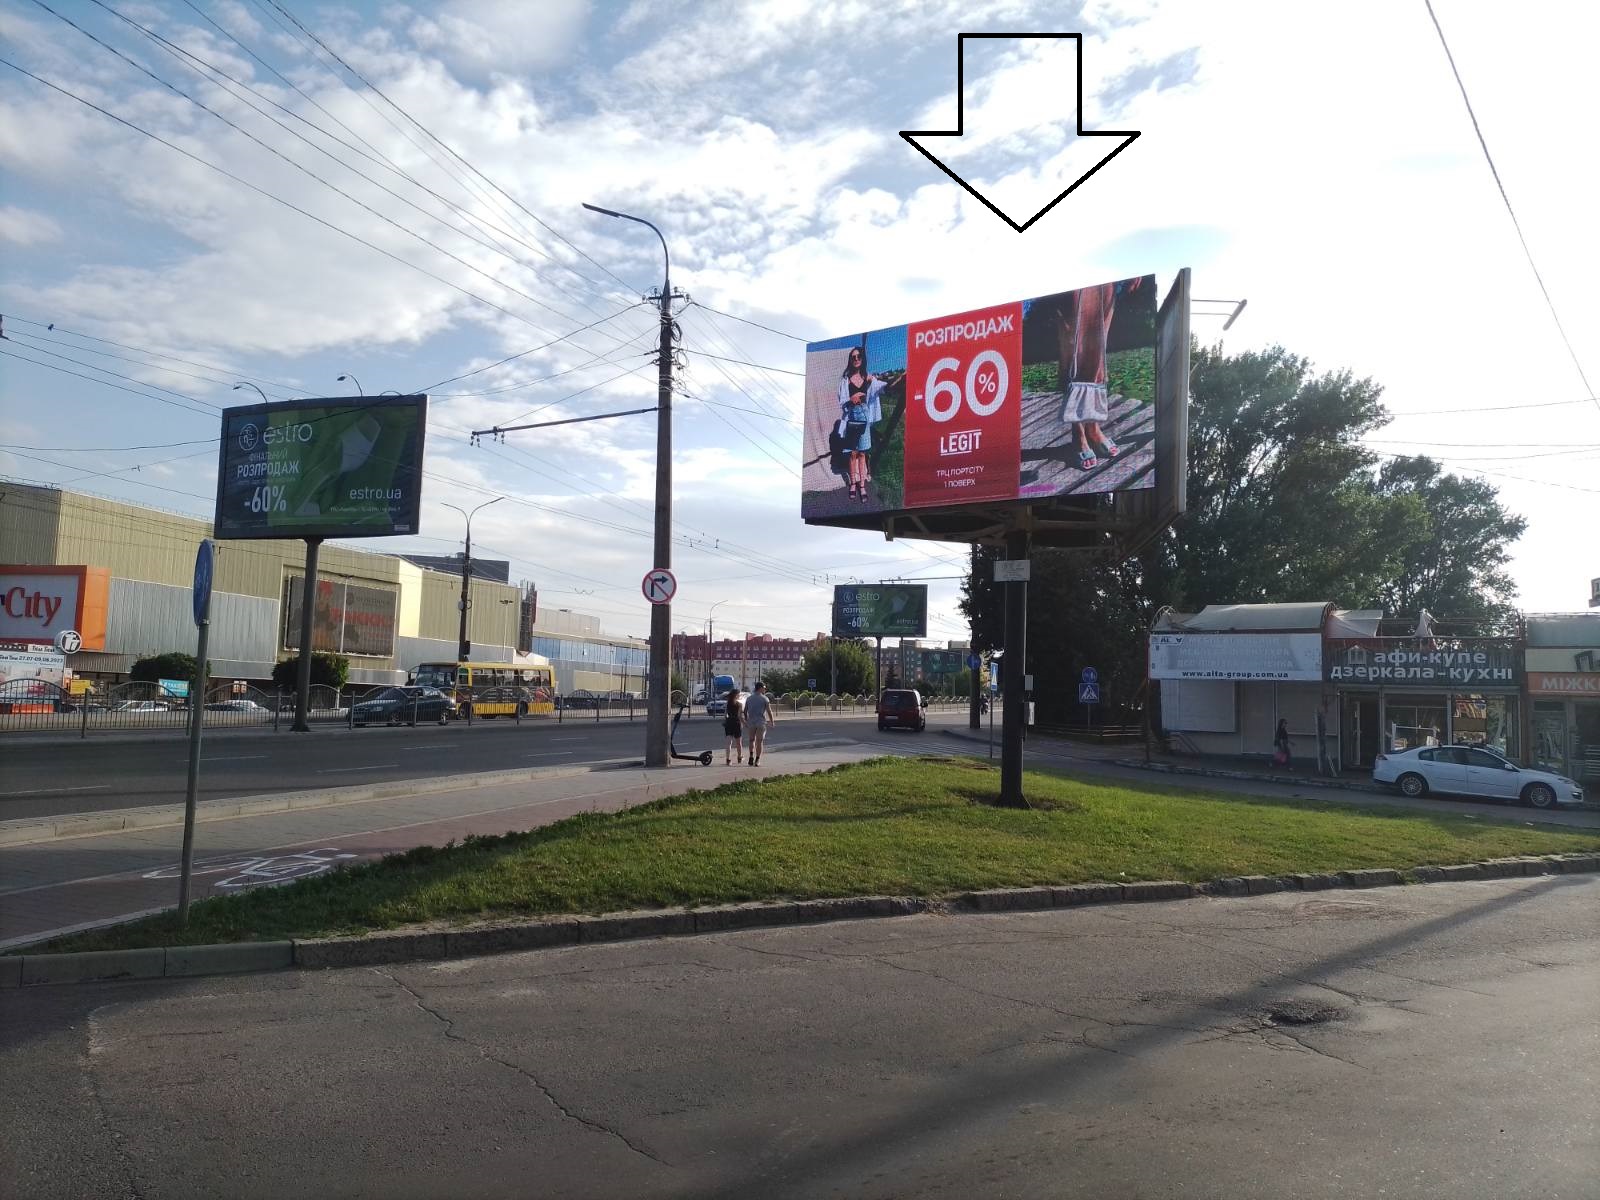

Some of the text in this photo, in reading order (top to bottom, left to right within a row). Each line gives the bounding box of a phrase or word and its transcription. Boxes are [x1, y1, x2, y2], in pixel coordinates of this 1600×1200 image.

[915, 314, 1014, 349] РОЗПРОДАЖ
[263, 420, 313, 444] estro
[940, 430, 982, 455] LEGIT
[237, 459, 300, 478] РОЗПРОДАЖ
[936, 469, 950, 479] ТРЦ
[948, 478, 976, 488] ПОВЕРХ
[243, 485, 287, 513] -60%
[349, 487, 402, 500] estro.ua
[855, 591, 880, 601] estro
[847, 616, 870, 628] -60%
[1182, 670, 1289, 679] www.alta-group.com.ua
